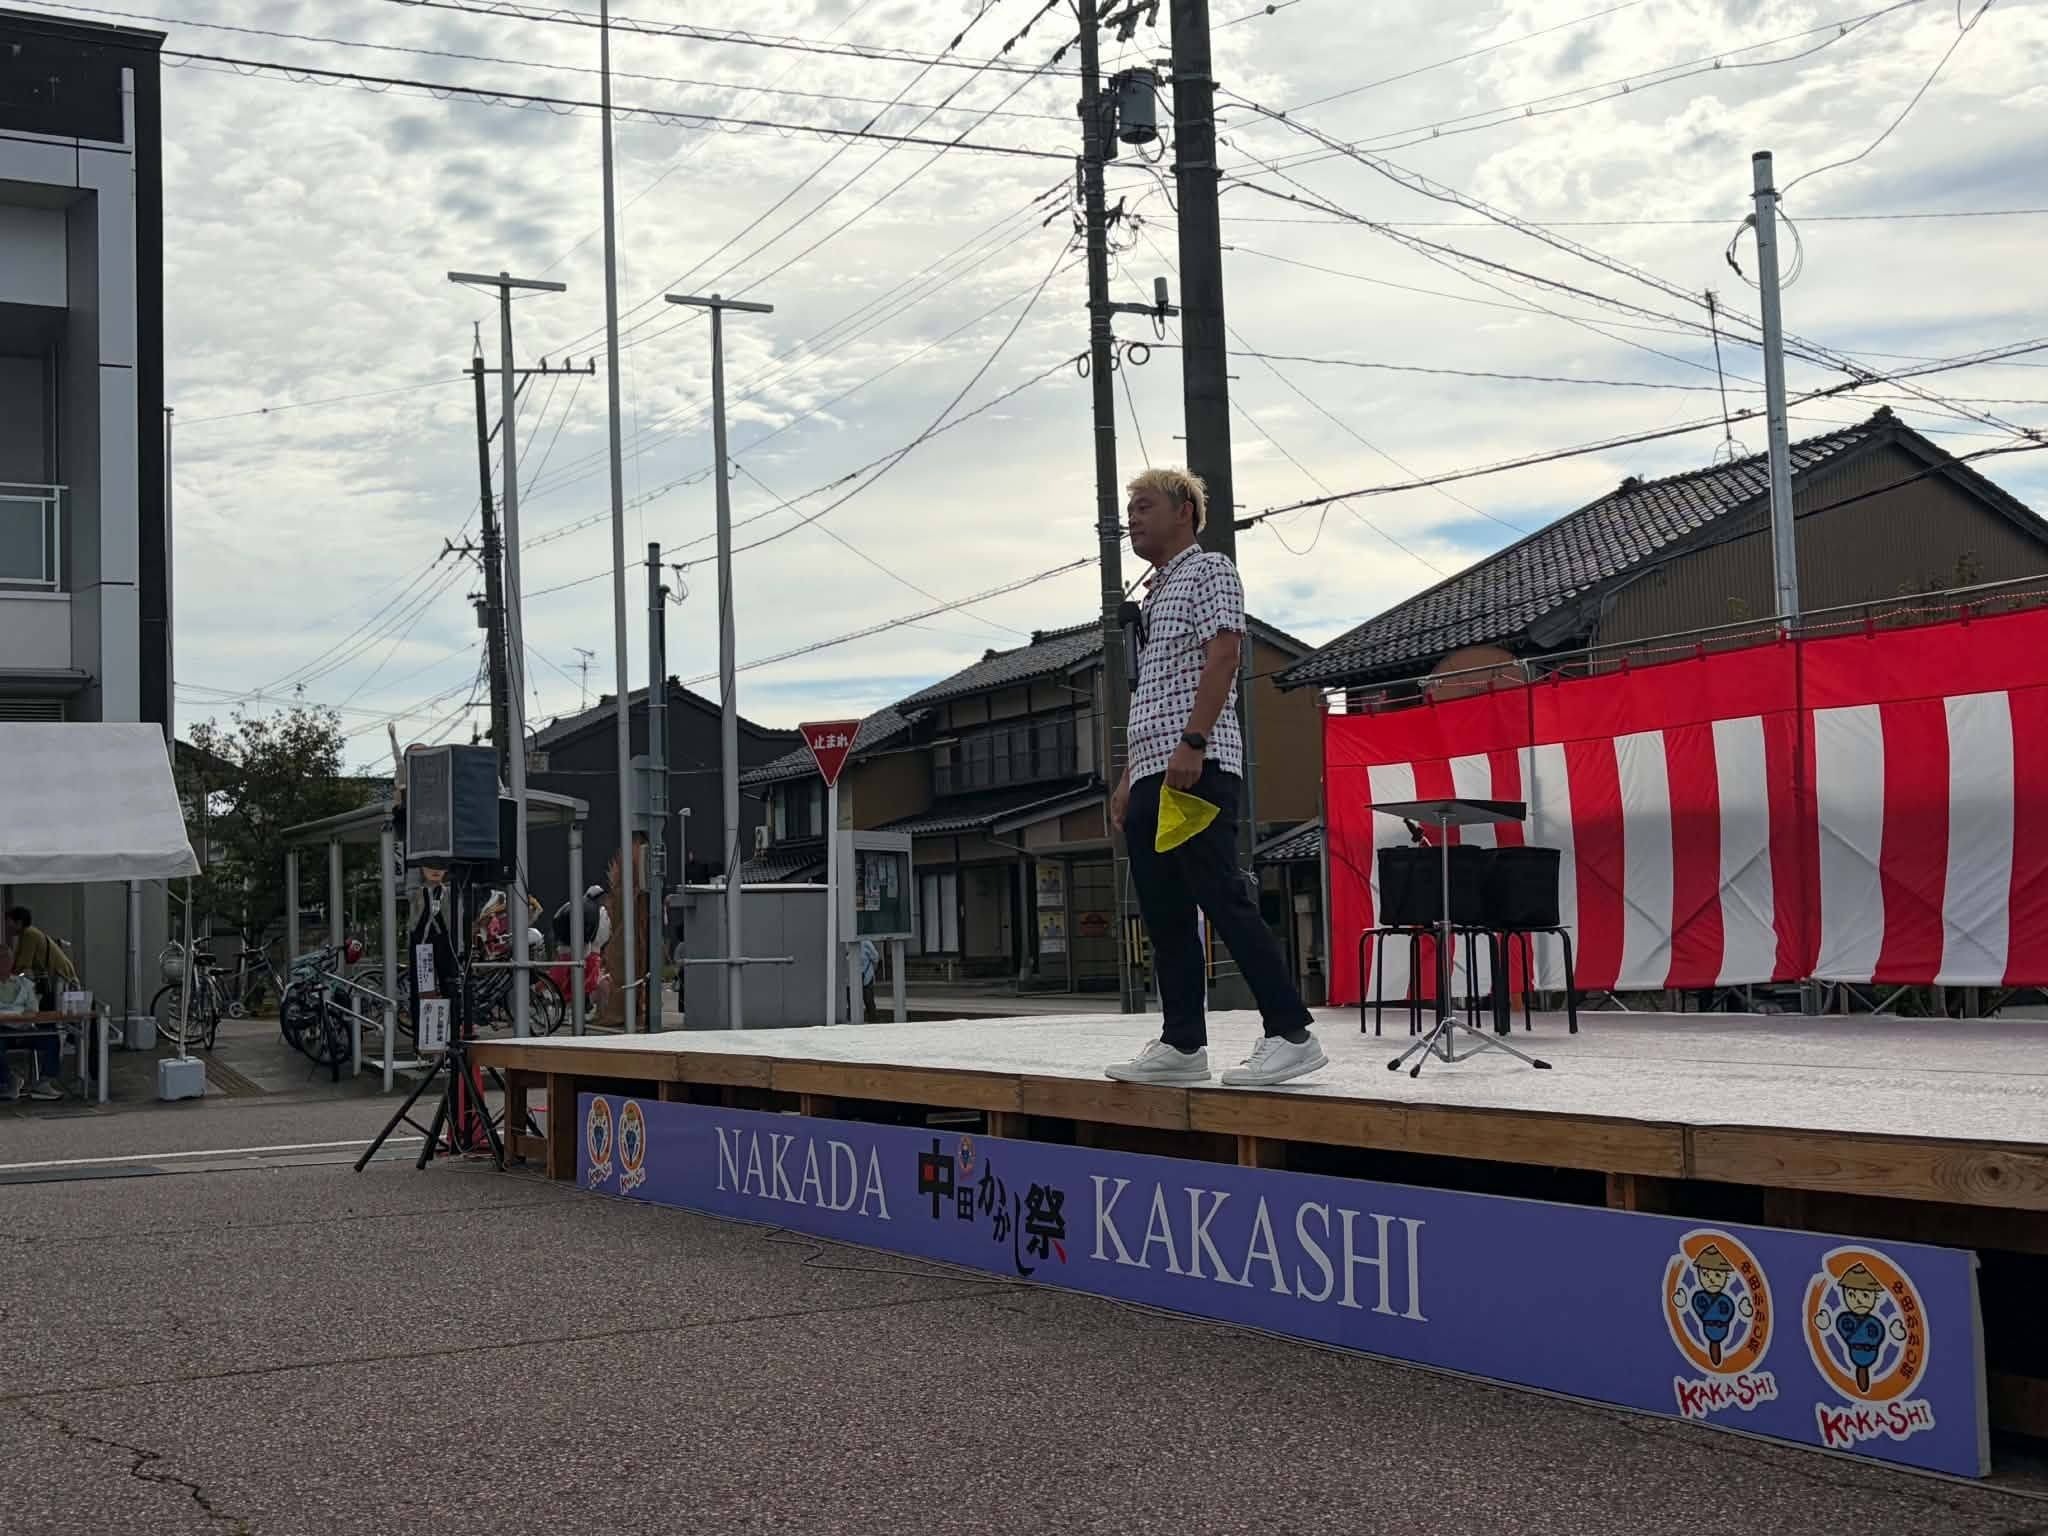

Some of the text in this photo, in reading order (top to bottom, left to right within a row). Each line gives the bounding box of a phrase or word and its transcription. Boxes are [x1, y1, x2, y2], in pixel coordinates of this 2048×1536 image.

[813, 732, 849, 750] 止まれ
[714, 1127, 1430, 1323] NAKADA 中田かかし祭 KAKASHI
[1677, 1374, 1775, 1418] KAKASHI
[1819, 1403, 1932, 1447] KAKASHI
